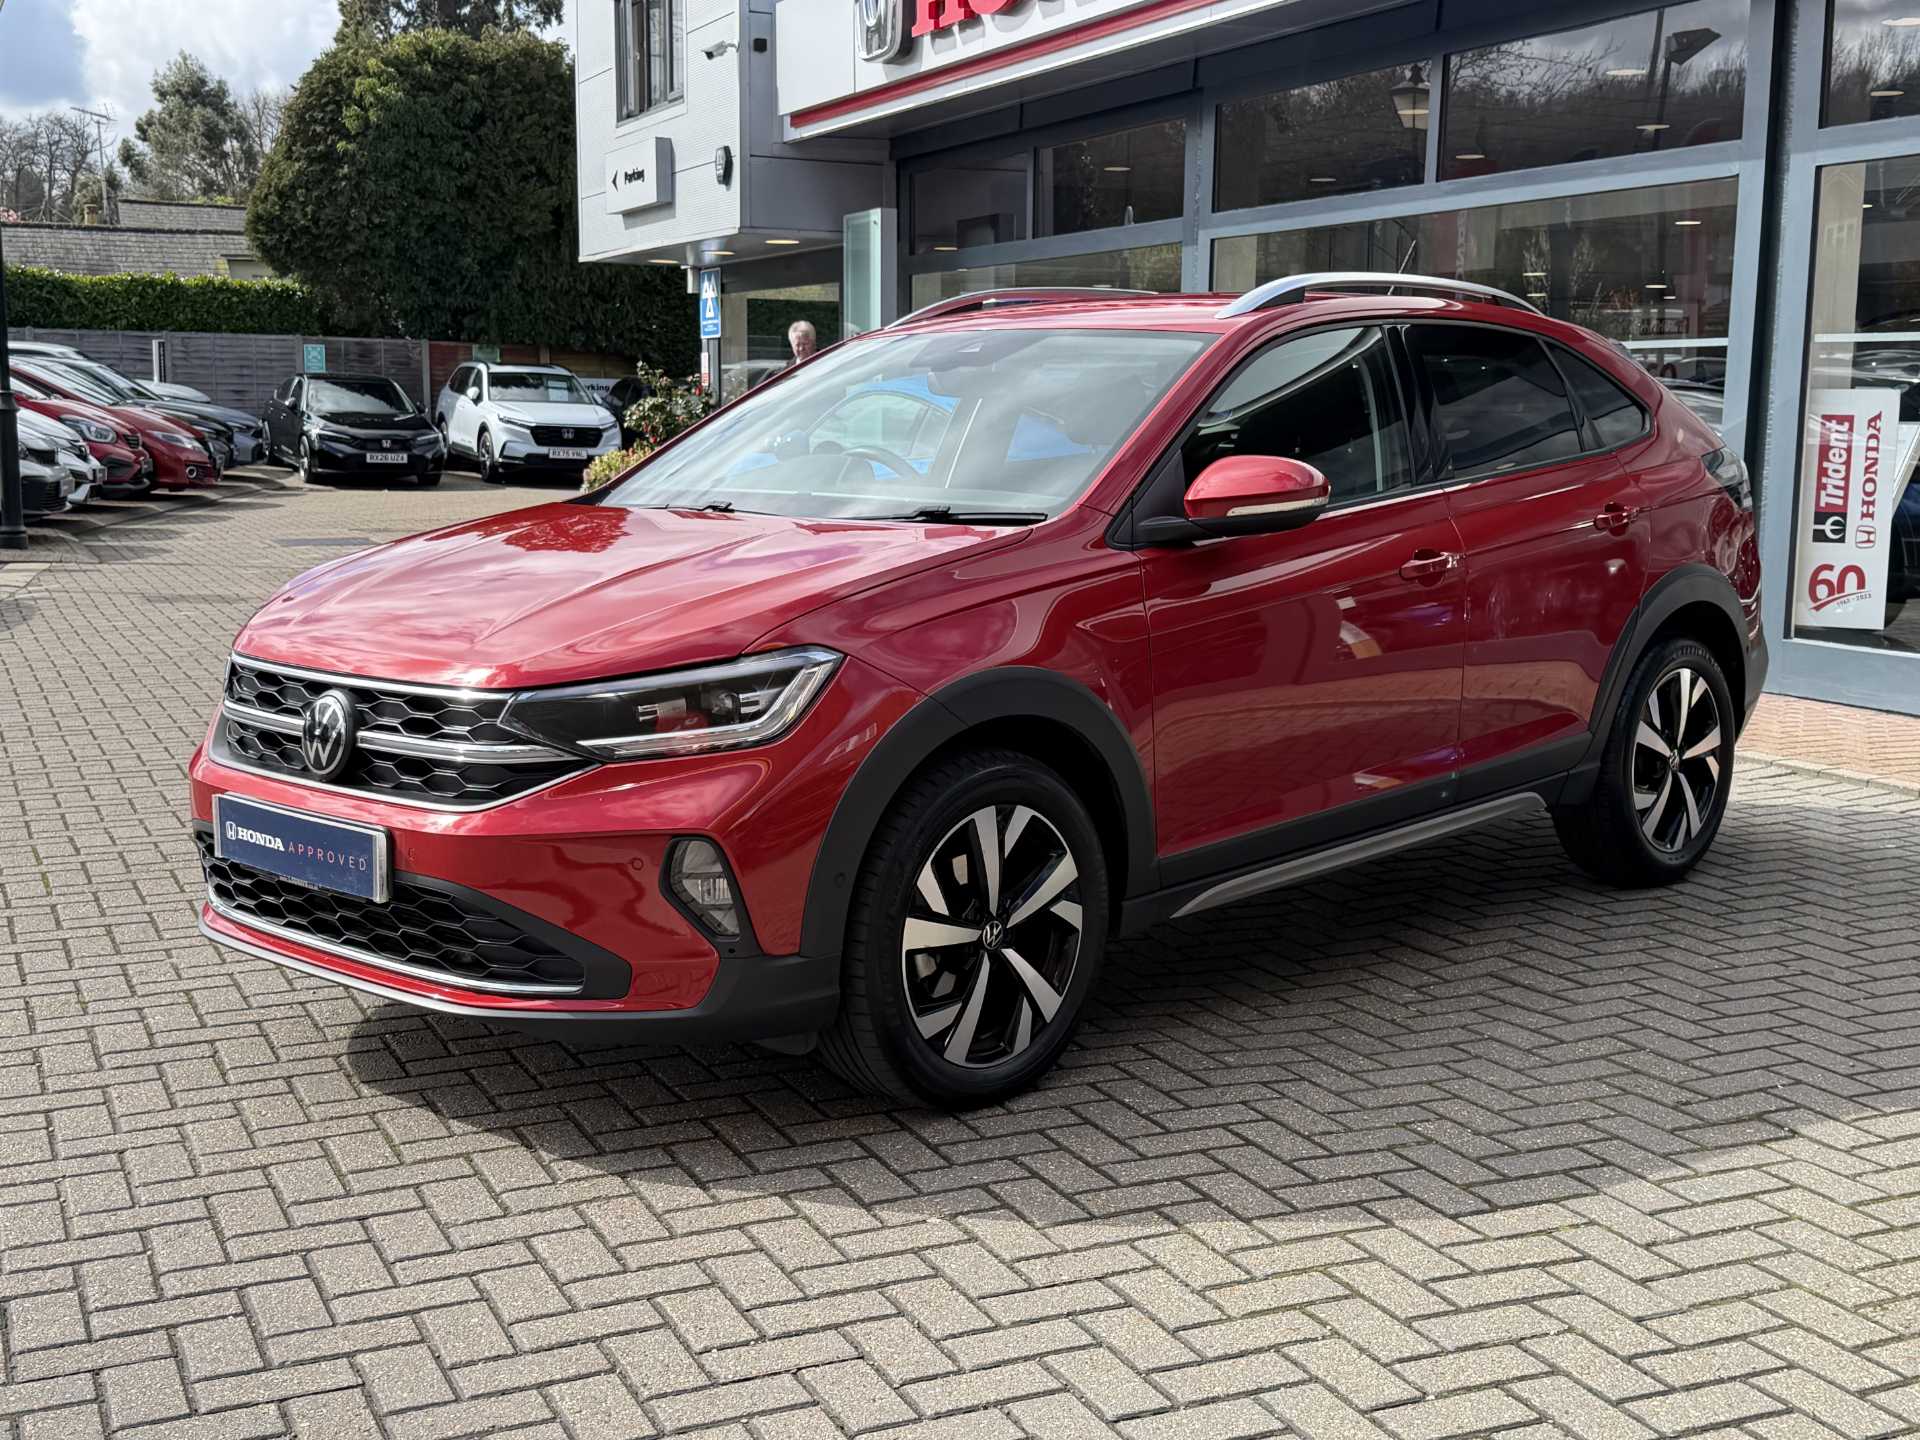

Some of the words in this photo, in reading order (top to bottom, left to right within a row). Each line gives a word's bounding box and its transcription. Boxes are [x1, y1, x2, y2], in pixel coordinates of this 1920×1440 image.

[624, 168, 645, 184] Parking
[1820, 420, 1850, 508] Trident
[1860, 410, 1883, 521] HONDA
[1808, 564, 1866, 604] 60
[238, 827, 285, 851] HONDA
[288, 842, 366, 871] APPROVED
